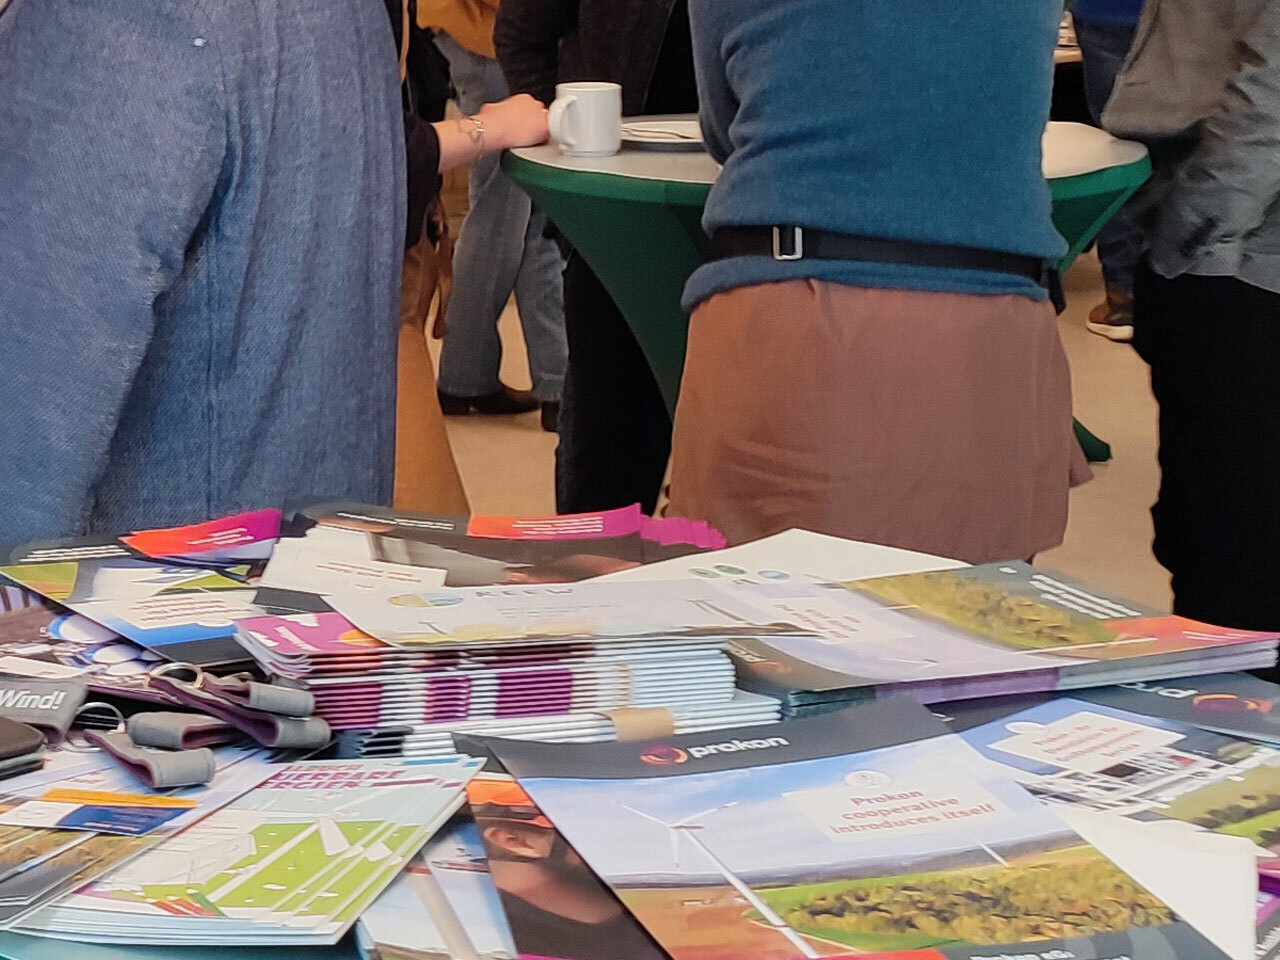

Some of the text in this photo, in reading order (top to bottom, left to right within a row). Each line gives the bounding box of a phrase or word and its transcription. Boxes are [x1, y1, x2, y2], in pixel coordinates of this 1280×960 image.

[687, 736, 790, 758] prokon
[842, 796, 960, 820] cooperative
[850, 790, 924, 806] Prokon
